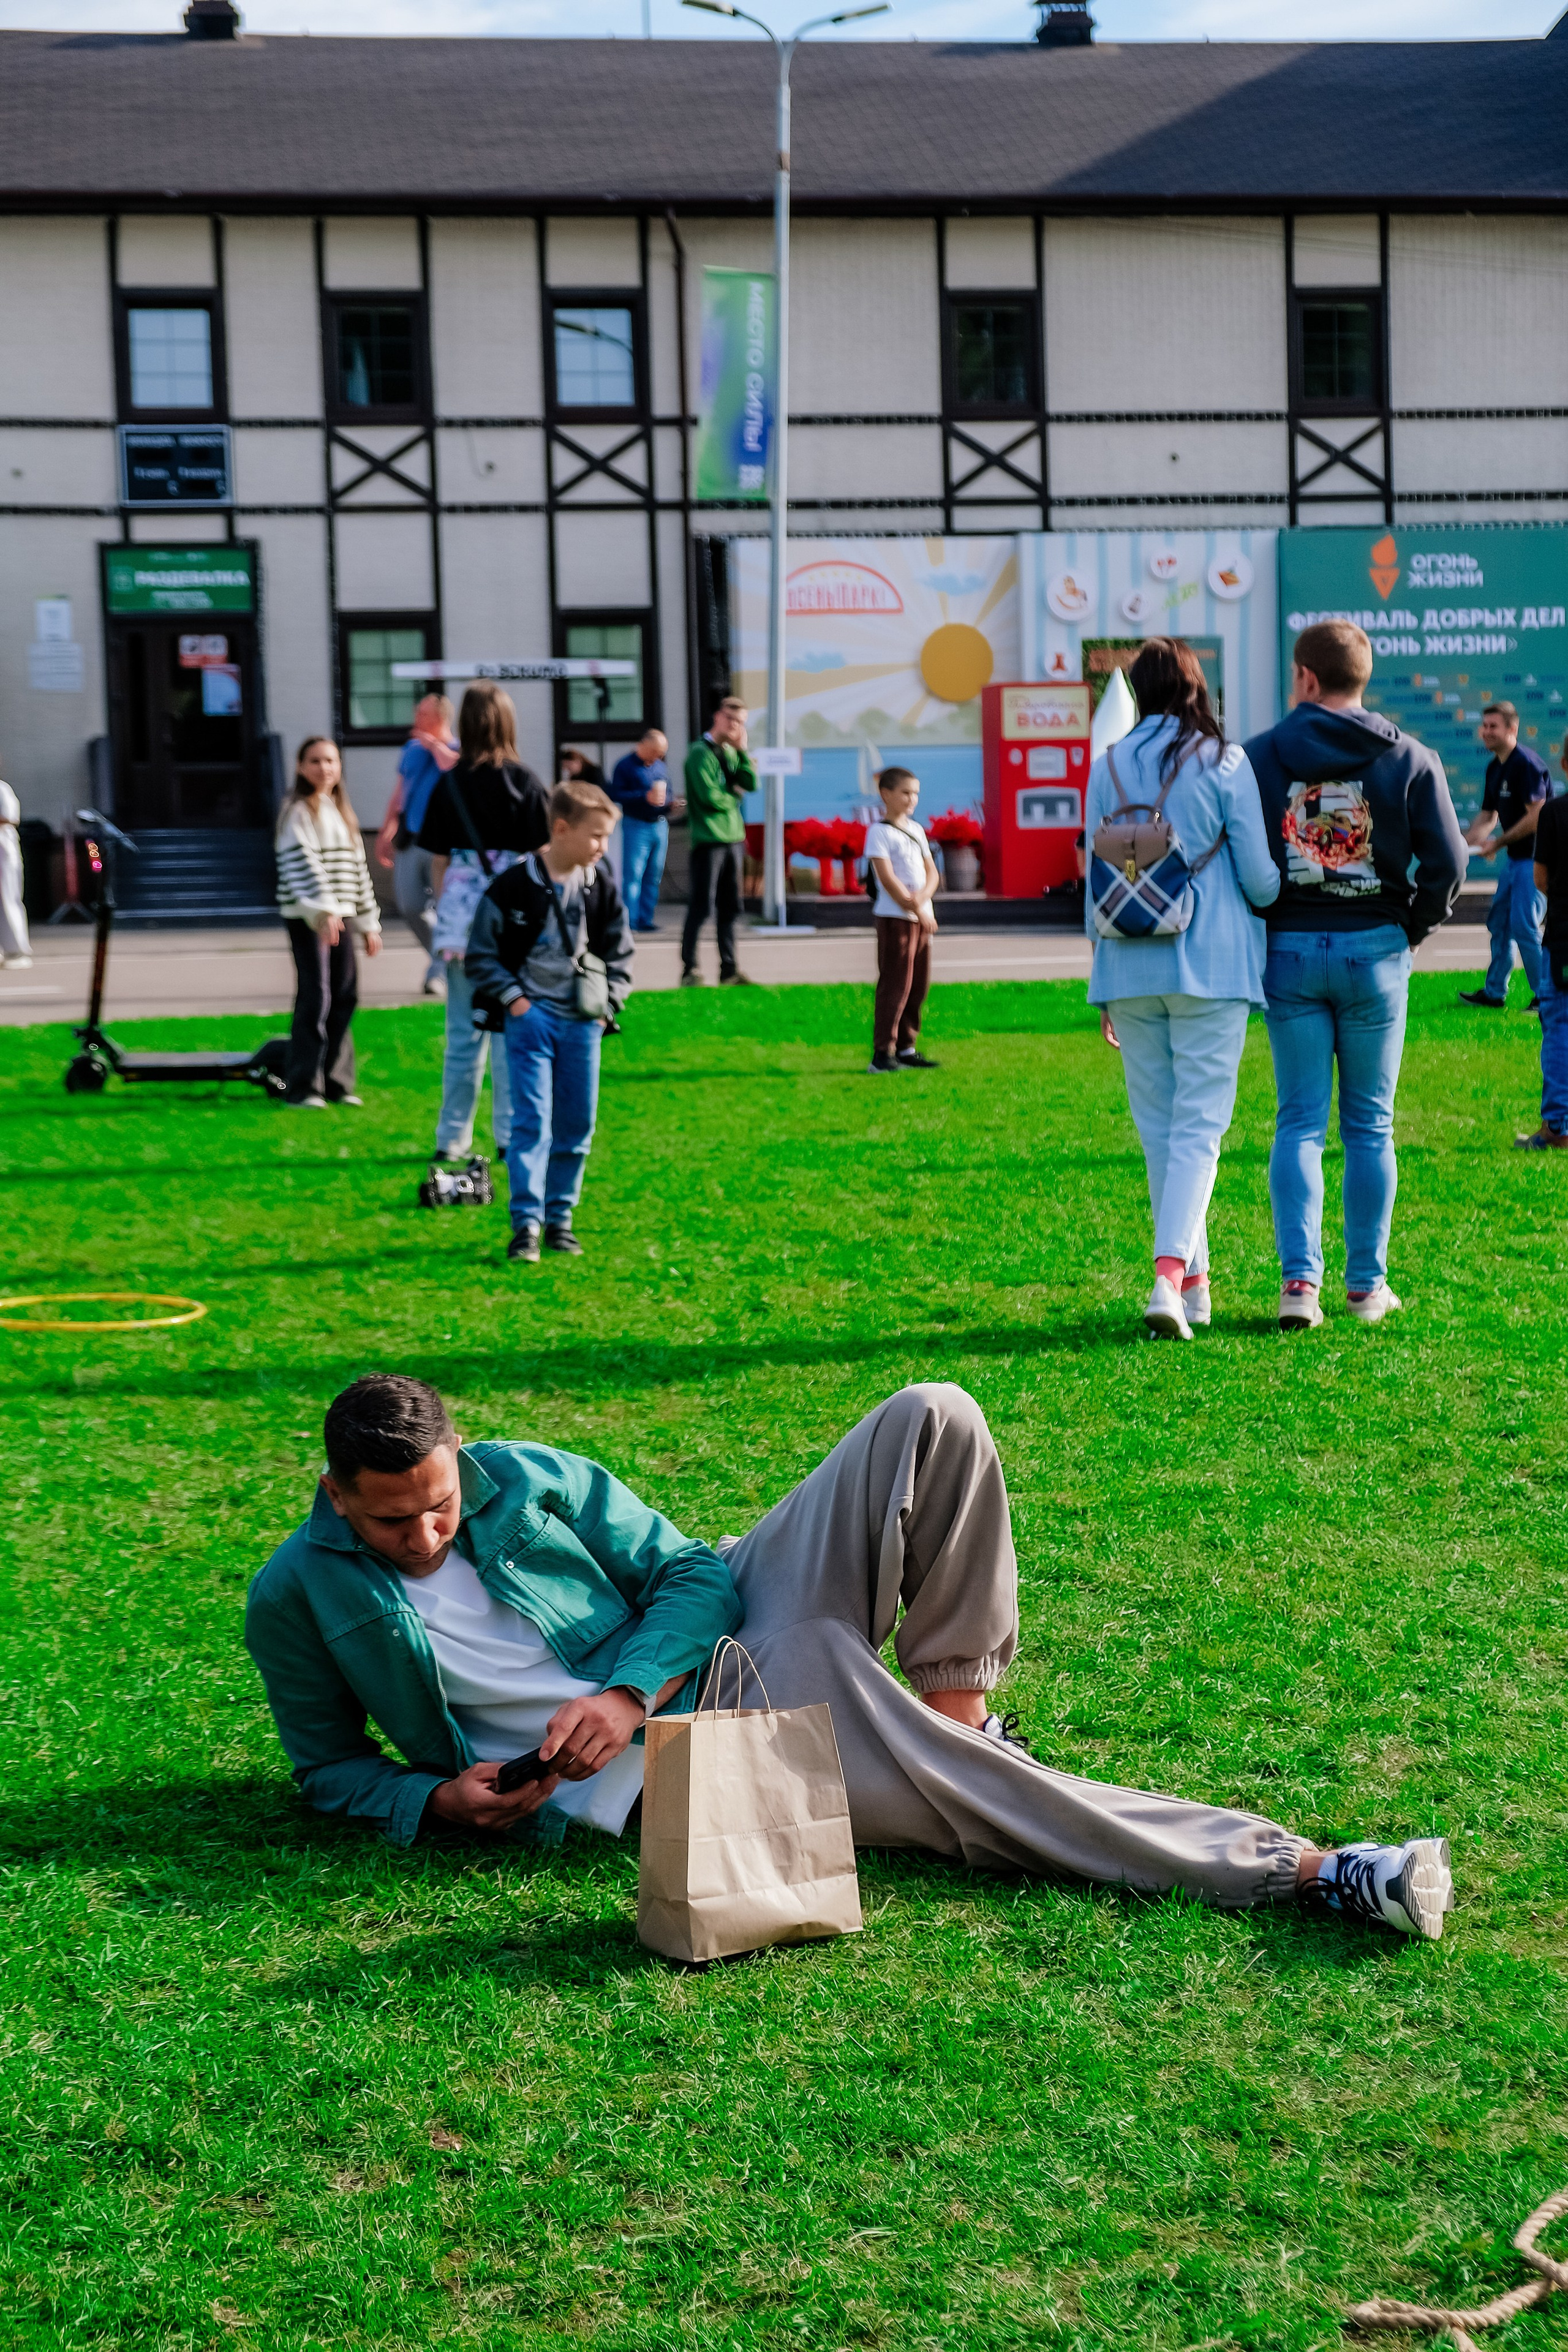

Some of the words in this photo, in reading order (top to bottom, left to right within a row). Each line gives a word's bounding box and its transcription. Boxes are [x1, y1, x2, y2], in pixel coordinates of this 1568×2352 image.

[746, 281, 765, 368] МЕСТО
[744, 372, 765, 452] СИЛЫ
[1411, 553, 1479, 571] ОГОНЬ
[1408, 569, 1484, 589] ЖИЗНИ
[1422, 608, 1517, 631] ДОБРЫХ
[1520, 606, 1566, 630] ДЕЛ
[1017, 712, 1081, 728] ВОДА
